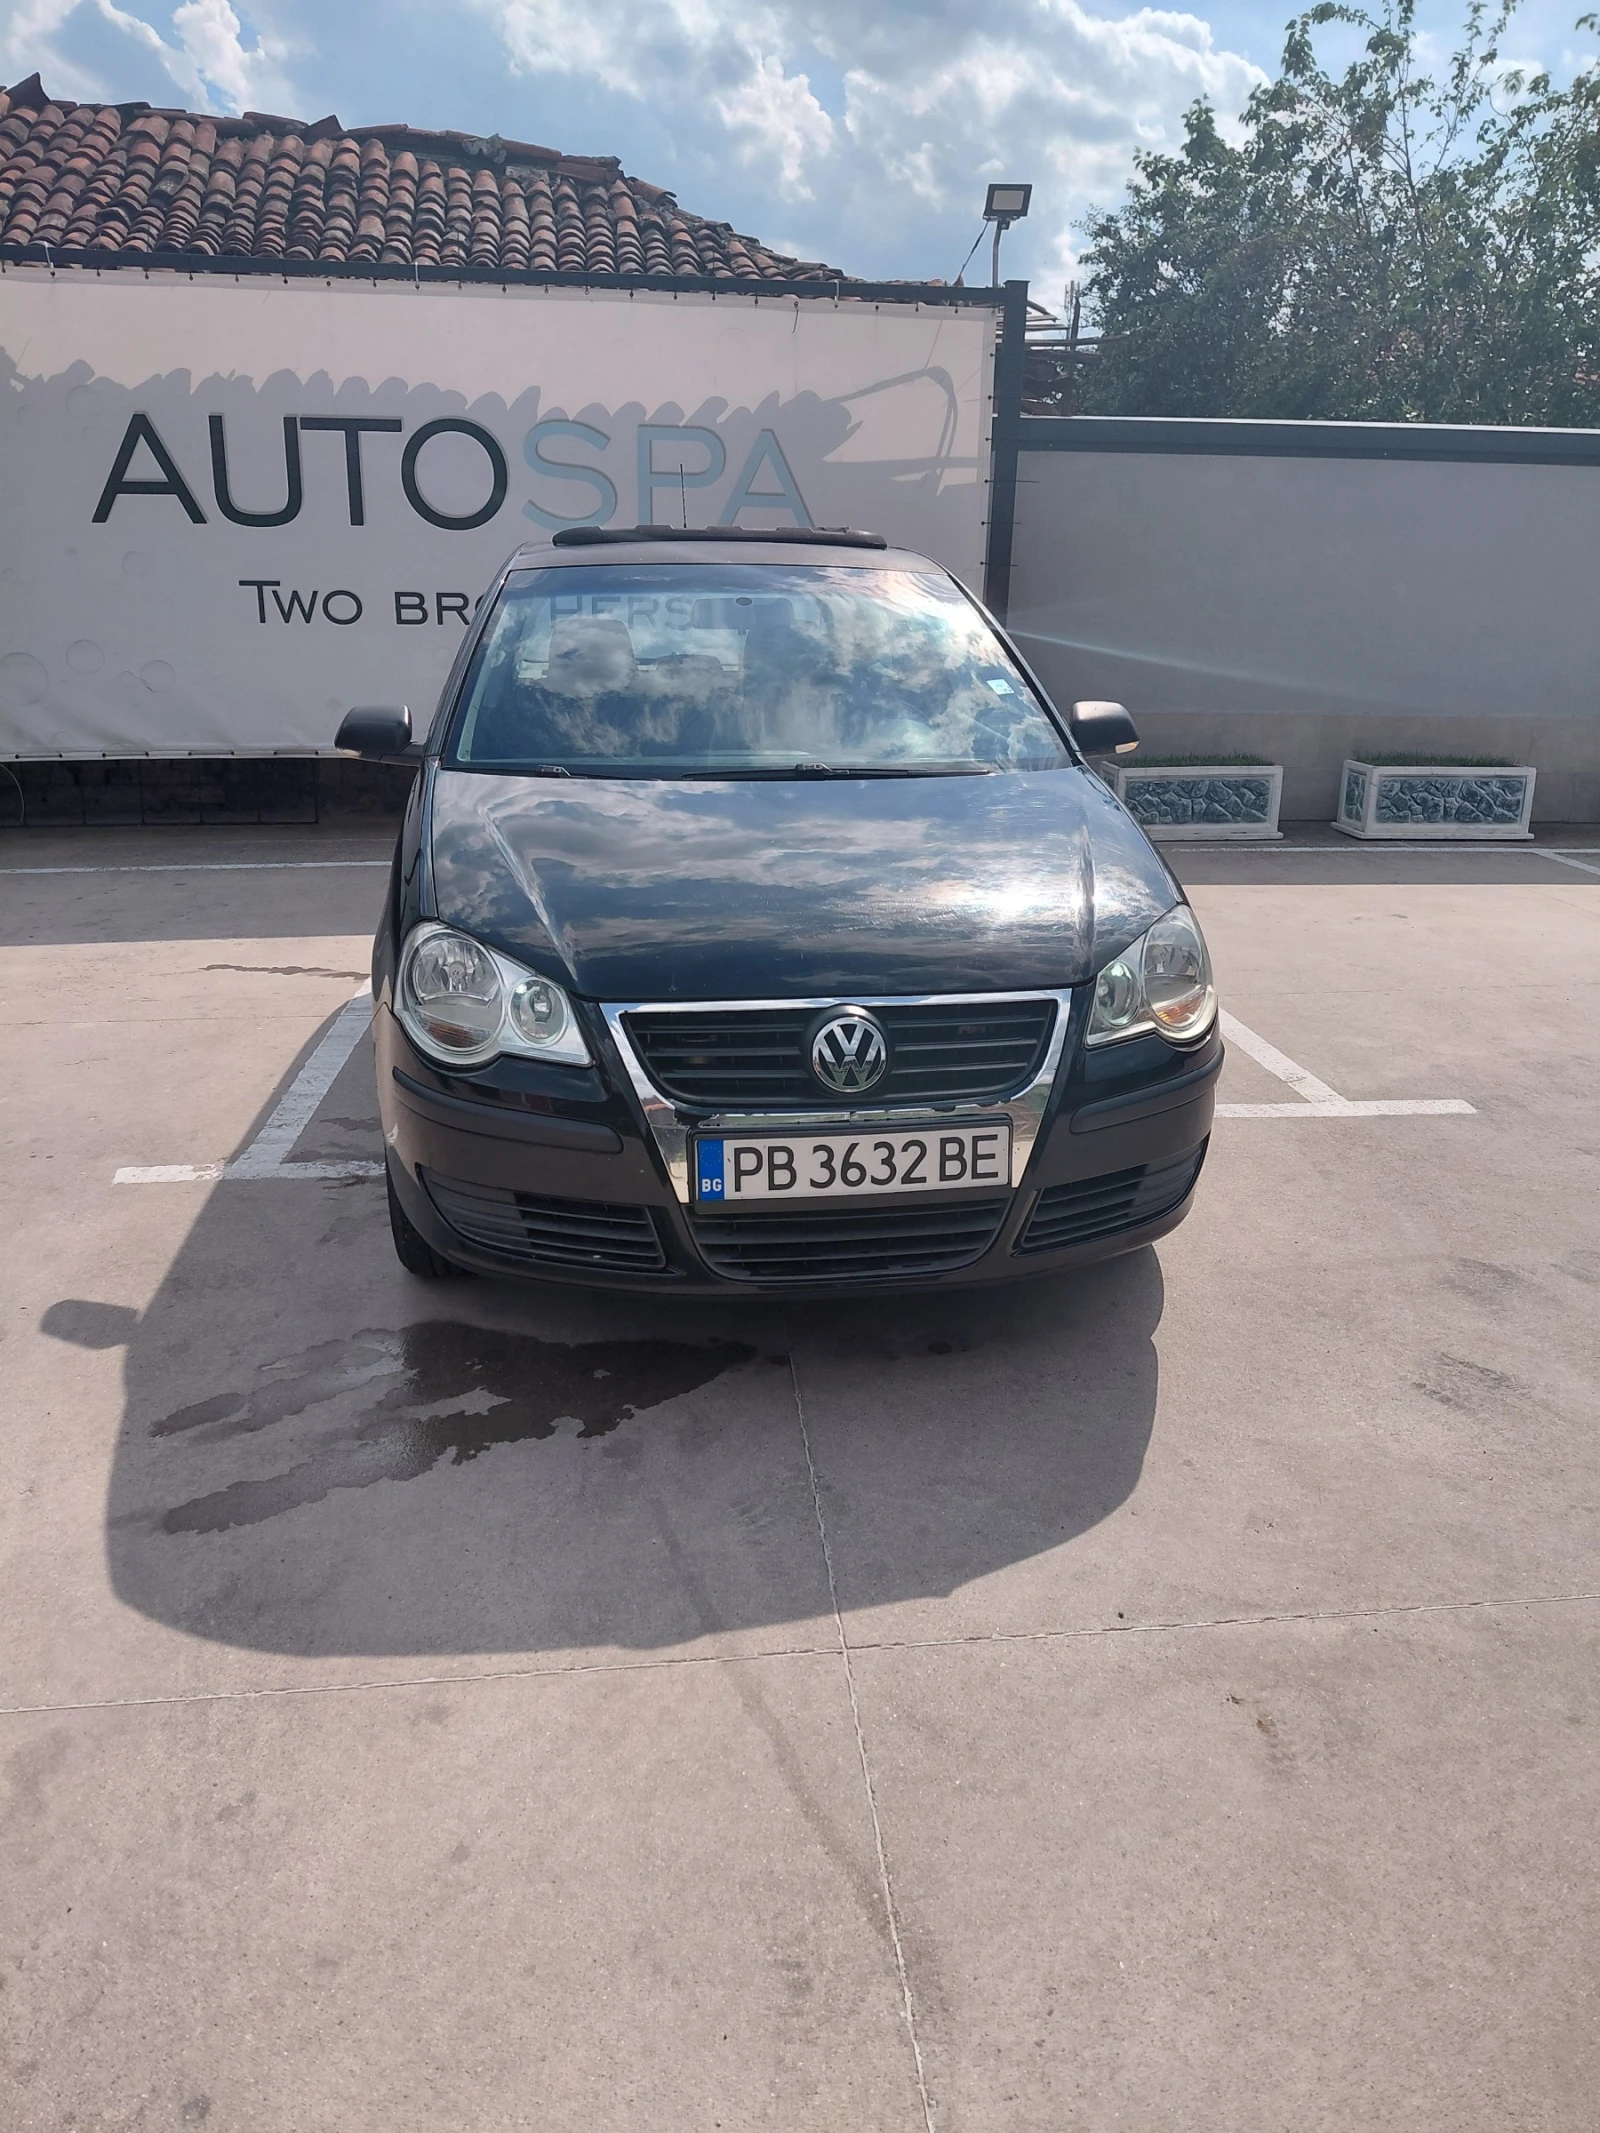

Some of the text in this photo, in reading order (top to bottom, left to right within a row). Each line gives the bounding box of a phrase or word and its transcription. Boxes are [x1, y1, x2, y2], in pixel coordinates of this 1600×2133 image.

[733, 1133, 999, 1193] PB 3632 BE
[701, 1178, 722, 1193] BG
